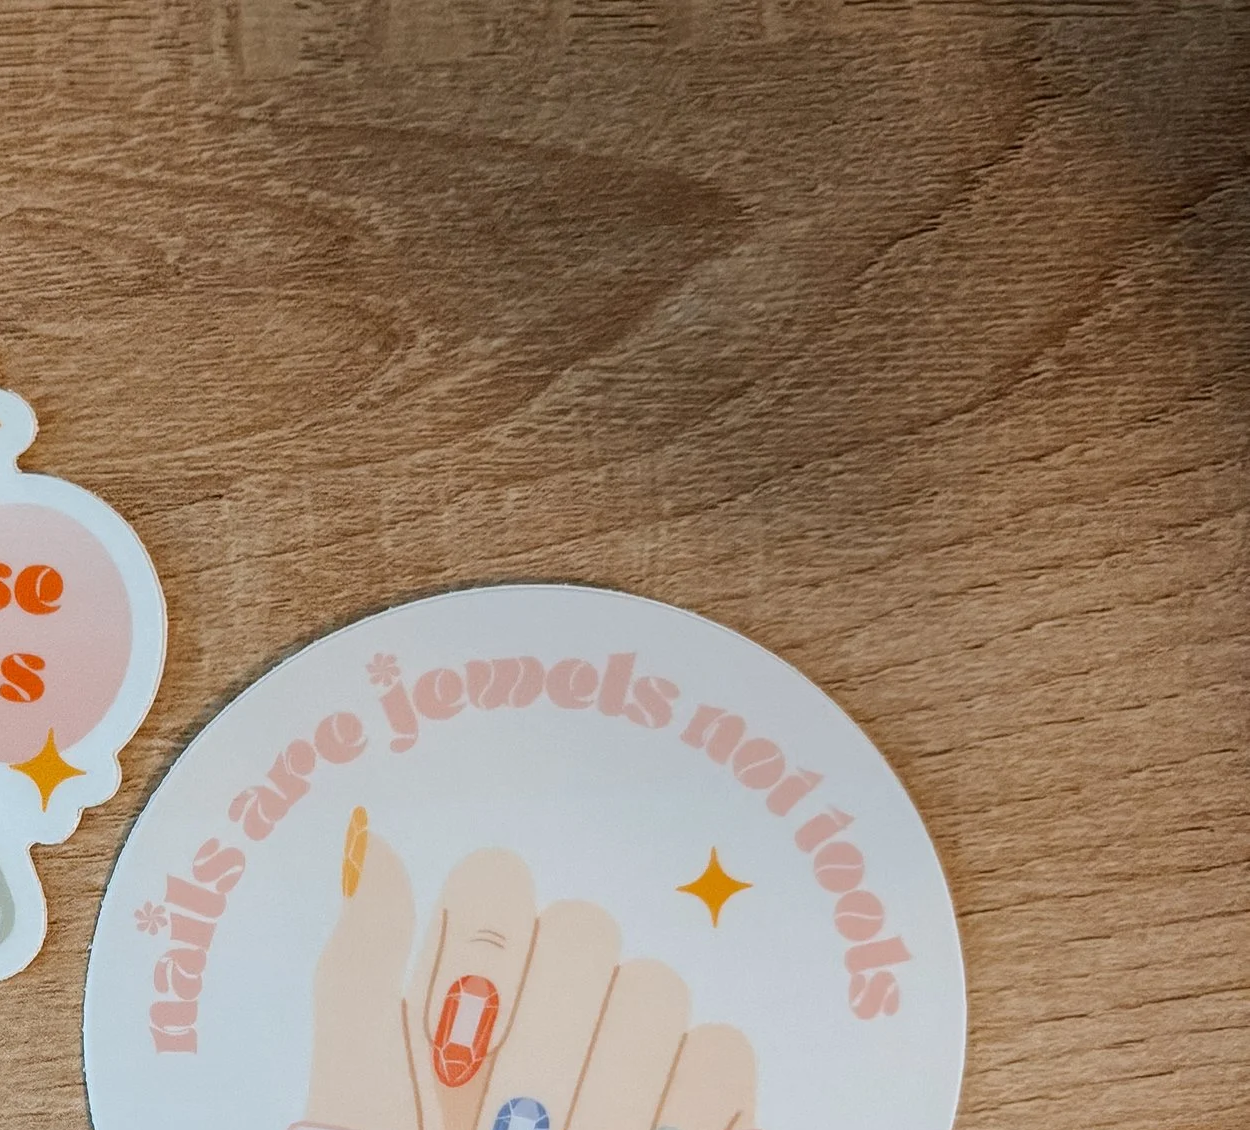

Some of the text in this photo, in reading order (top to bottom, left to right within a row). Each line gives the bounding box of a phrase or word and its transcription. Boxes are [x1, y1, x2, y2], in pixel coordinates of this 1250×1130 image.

[134, 651, 913, 1055] nails are jewels not tools
